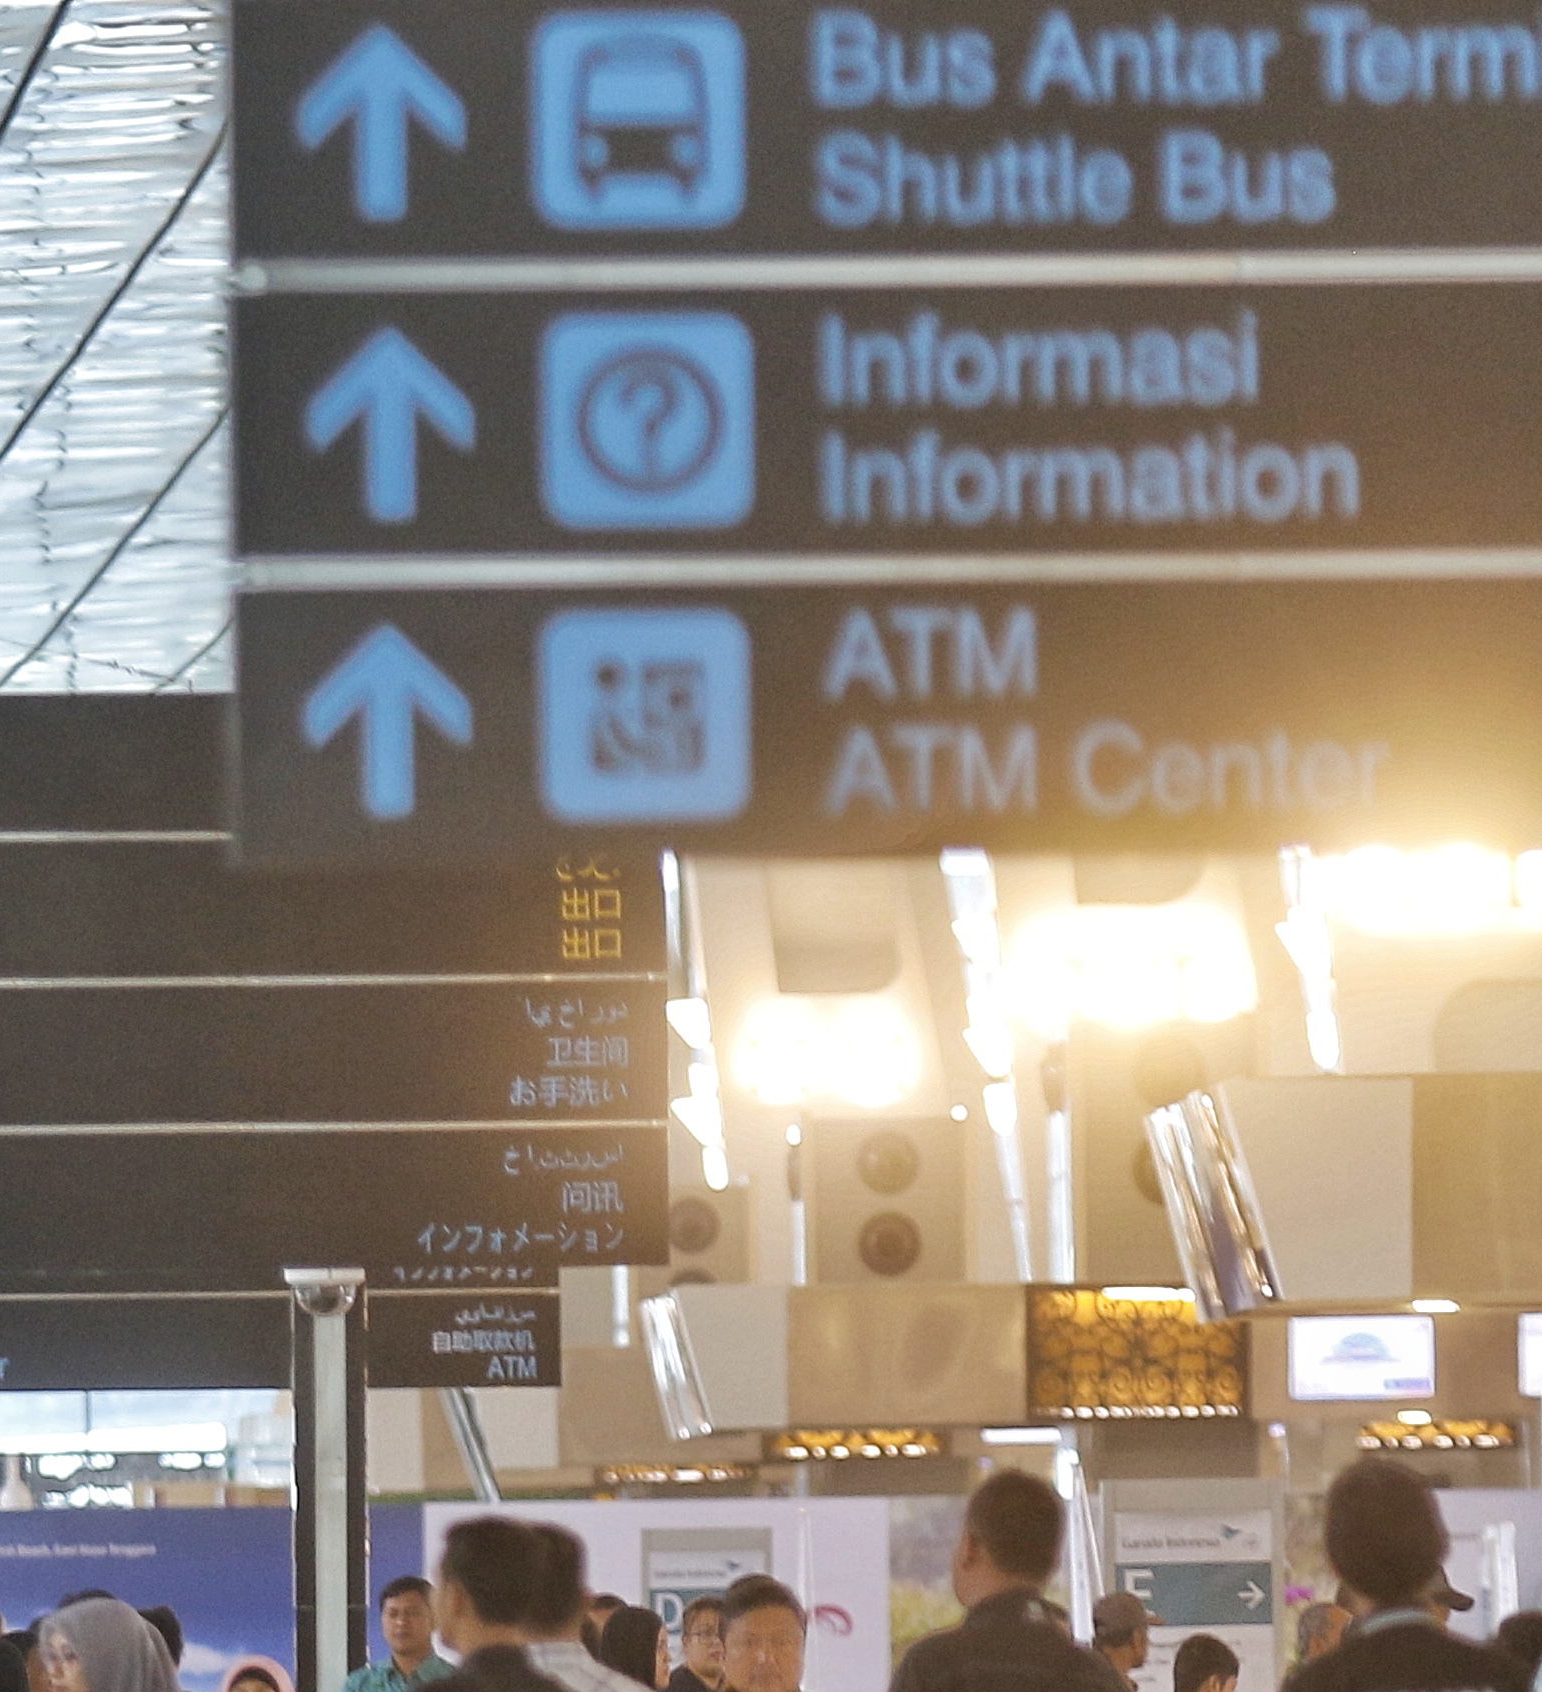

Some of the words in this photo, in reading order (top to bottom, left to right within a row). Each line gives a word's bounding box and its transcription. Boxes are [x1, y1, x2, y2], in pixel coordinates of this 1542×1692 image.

[813, 10, 996, 106] Bus
[1026, 11, 1279, 104] Antar
[817, 131, 1133, 224] Shuttle
[1160, 131, 1336, 223] Bus
[820, 311, 1259, 407] Informasi
[821, 429, 1360, 522] Information
[825, 607, 1037, 699] ATM
[828, 724, 1039, 816] ATM
[1073, 720, 1391, 816] Center
[562, 888, 621, 920] 出口
[562, 927, 622, 959] 出口
[547, 1036, 629, 1067] 卫生间
[510, 1076, 628, 1107] お手洗い
[562, 1181, 624, 1213] 问讯
[418, 1222, 623, 1254] インフォメーション
[487, 1355, 537, 1379] ATM
